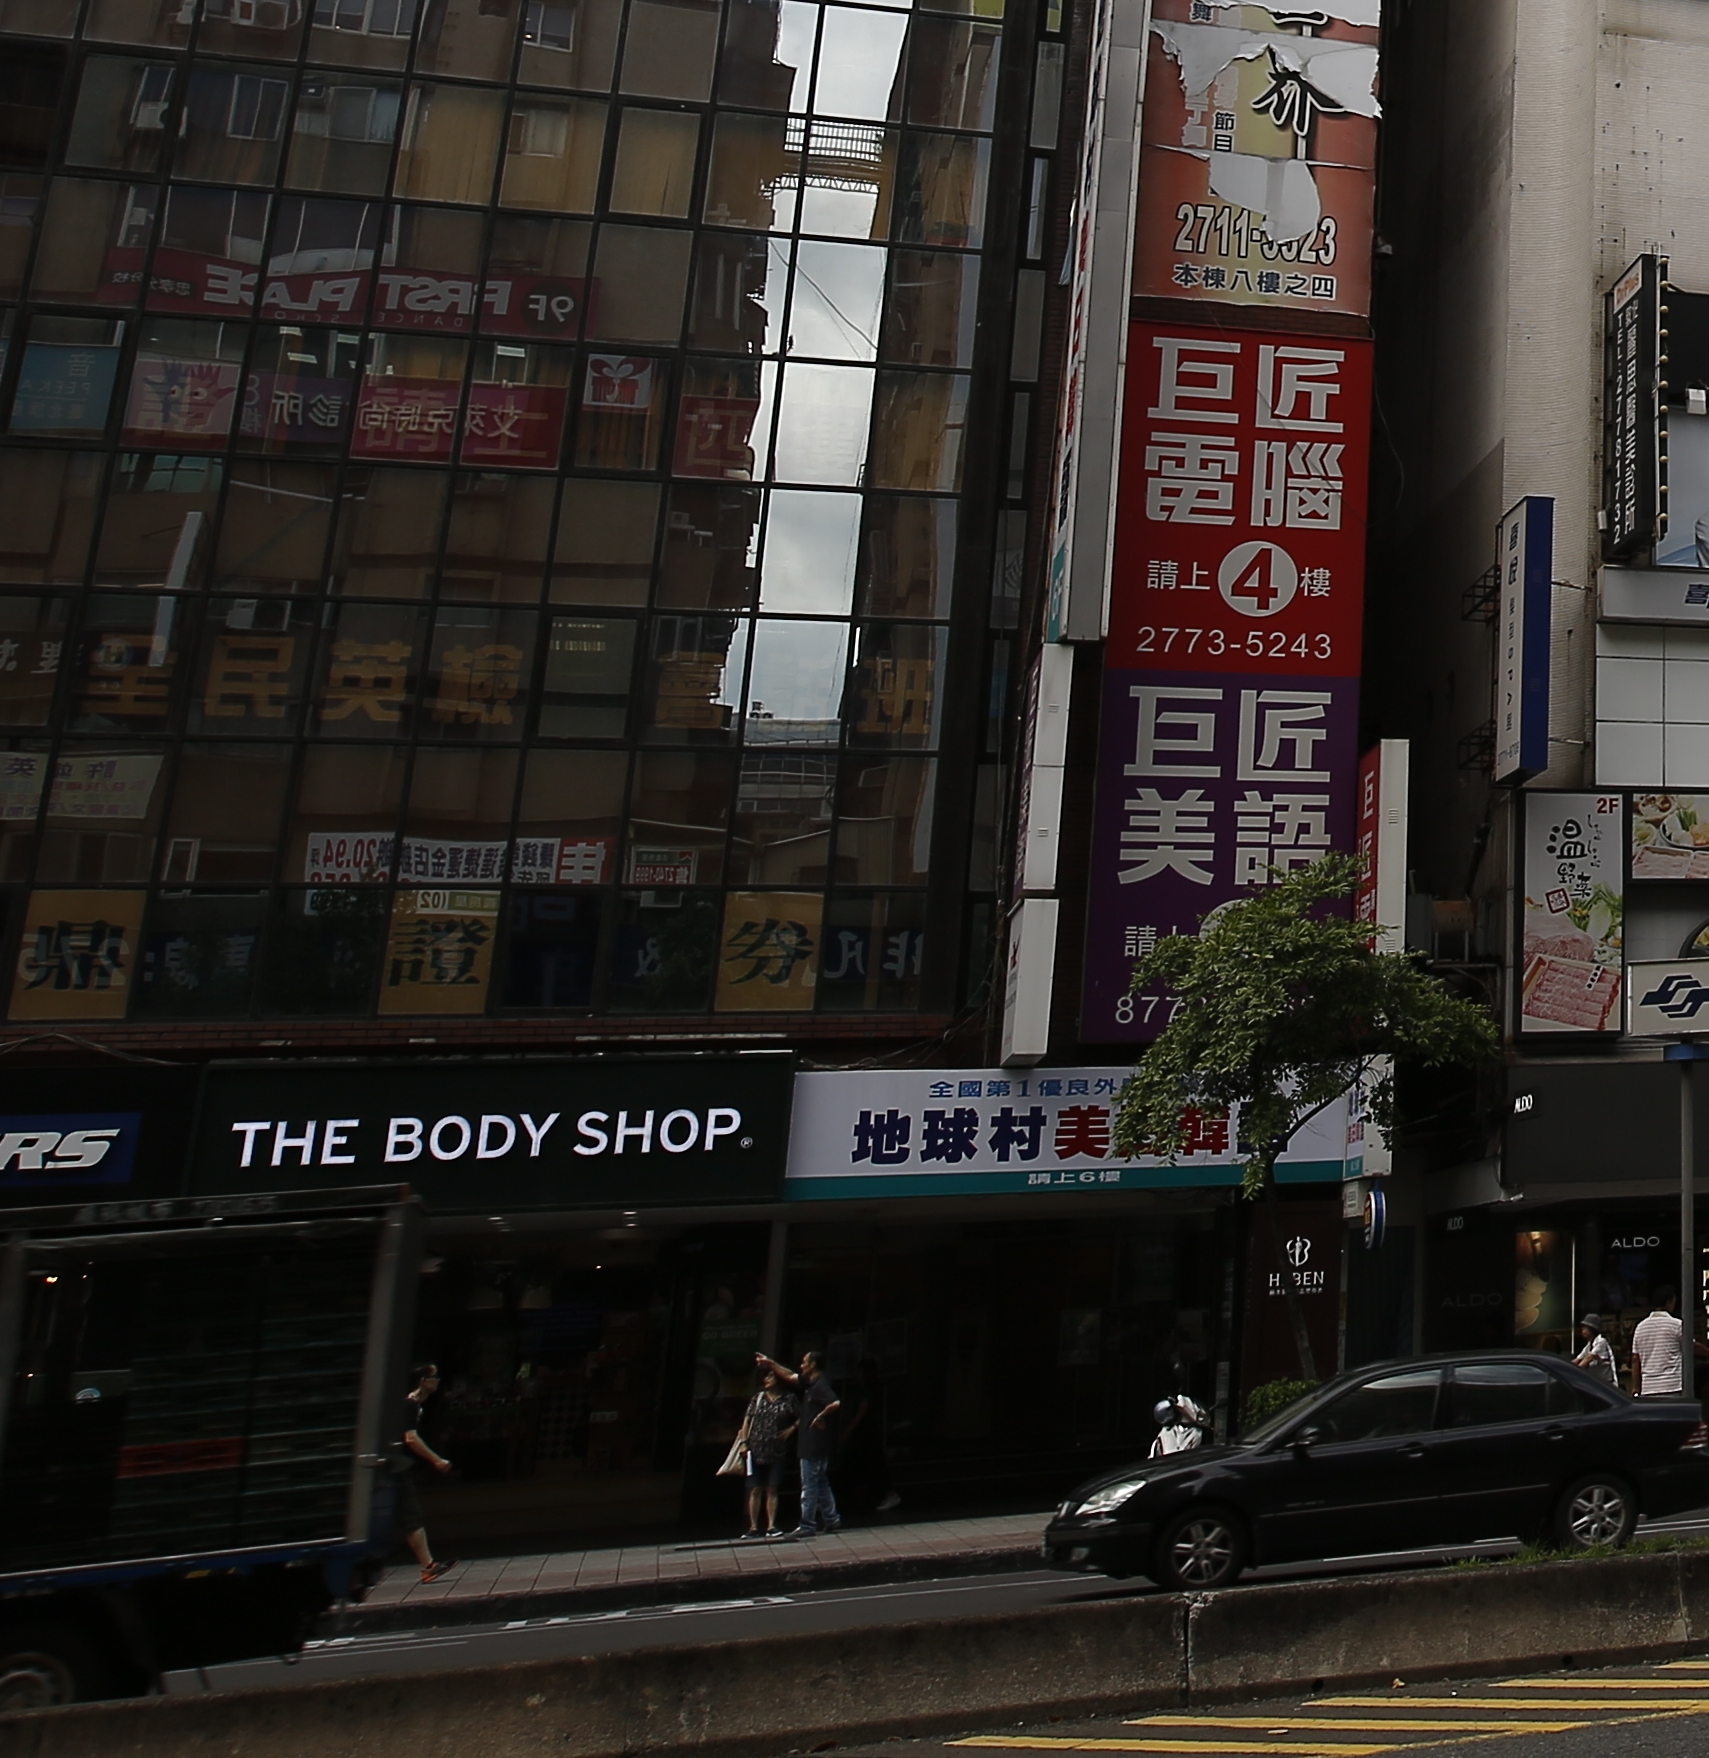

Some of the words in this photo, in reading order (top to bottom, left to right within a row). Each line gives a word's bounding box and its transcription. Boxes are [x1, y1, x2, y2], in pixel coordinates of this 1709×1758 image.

[1174, 264, 1335, 299] 本棟八樓之四
[1147, 334, 1346, 434] 巨匠
[1144, 431, 1346, 531] 電腦
[1136, 625, 1333, 661] 2773-5243
[1123, 684, 1333, 783] 巨匠
[1597, 798, 1619, 814] 2F
[1117, 788, 1332, 887] 美語
[1513, 1093, 1534, 1115] ALDO
[231, 1118, 360, 1168] THE
[383, 1111, 562, 1163] BODY
[1028, 1170, 1122, 1187] 請上6樓
[1610, 1235, 1661, 1250] ALDO
[1268, 1271, 1324, 1288] HBEN
